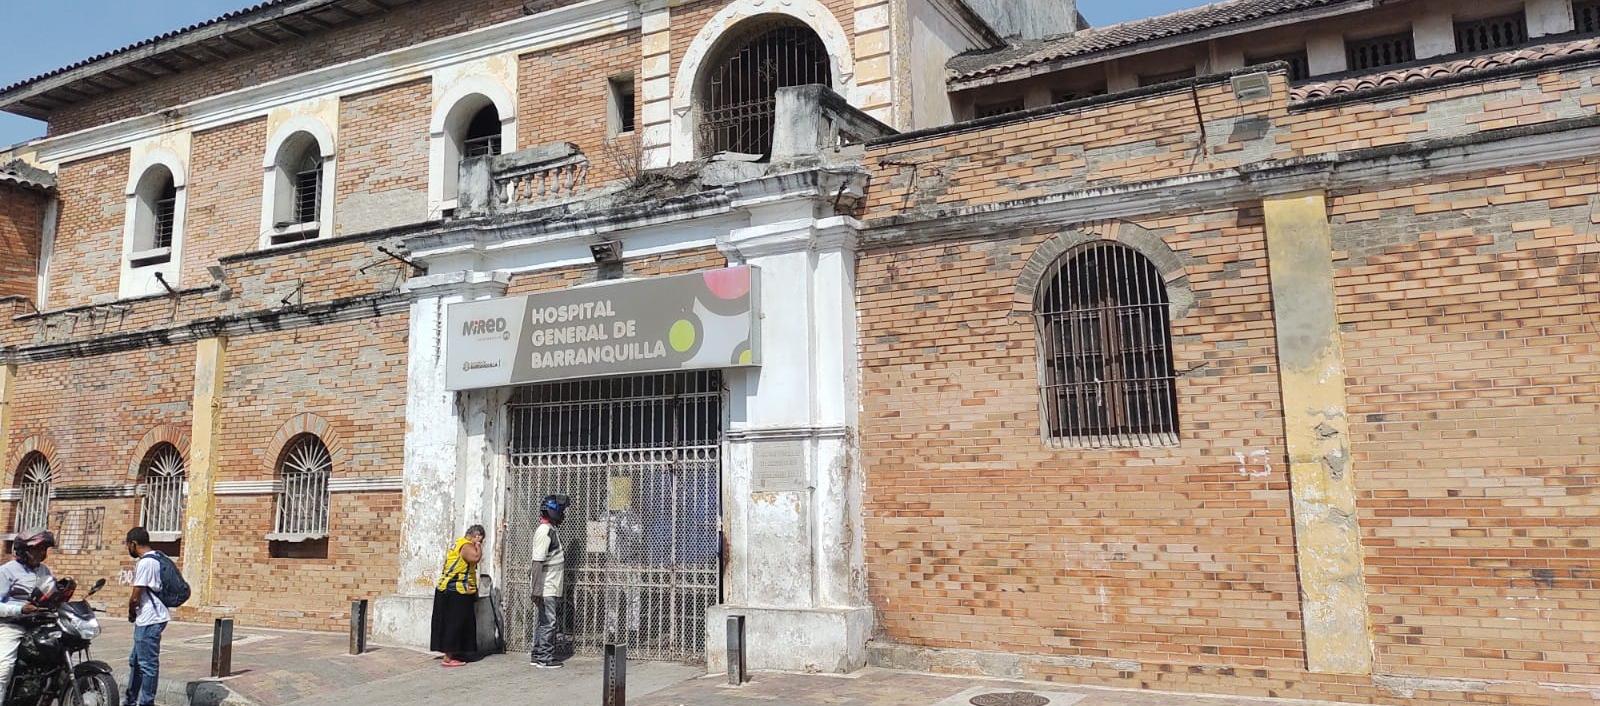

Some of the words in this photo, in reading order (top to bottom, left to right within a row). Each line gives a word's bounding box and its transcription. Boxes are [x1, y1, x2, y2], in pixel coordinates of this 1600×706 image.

[532, 300, 615, 324] HOSPITAL
[532, 323, 608, 346] GENERAL
[613, 320, 636, 338] DE
[532, 341, 666, 368] BARRANQUILLA
